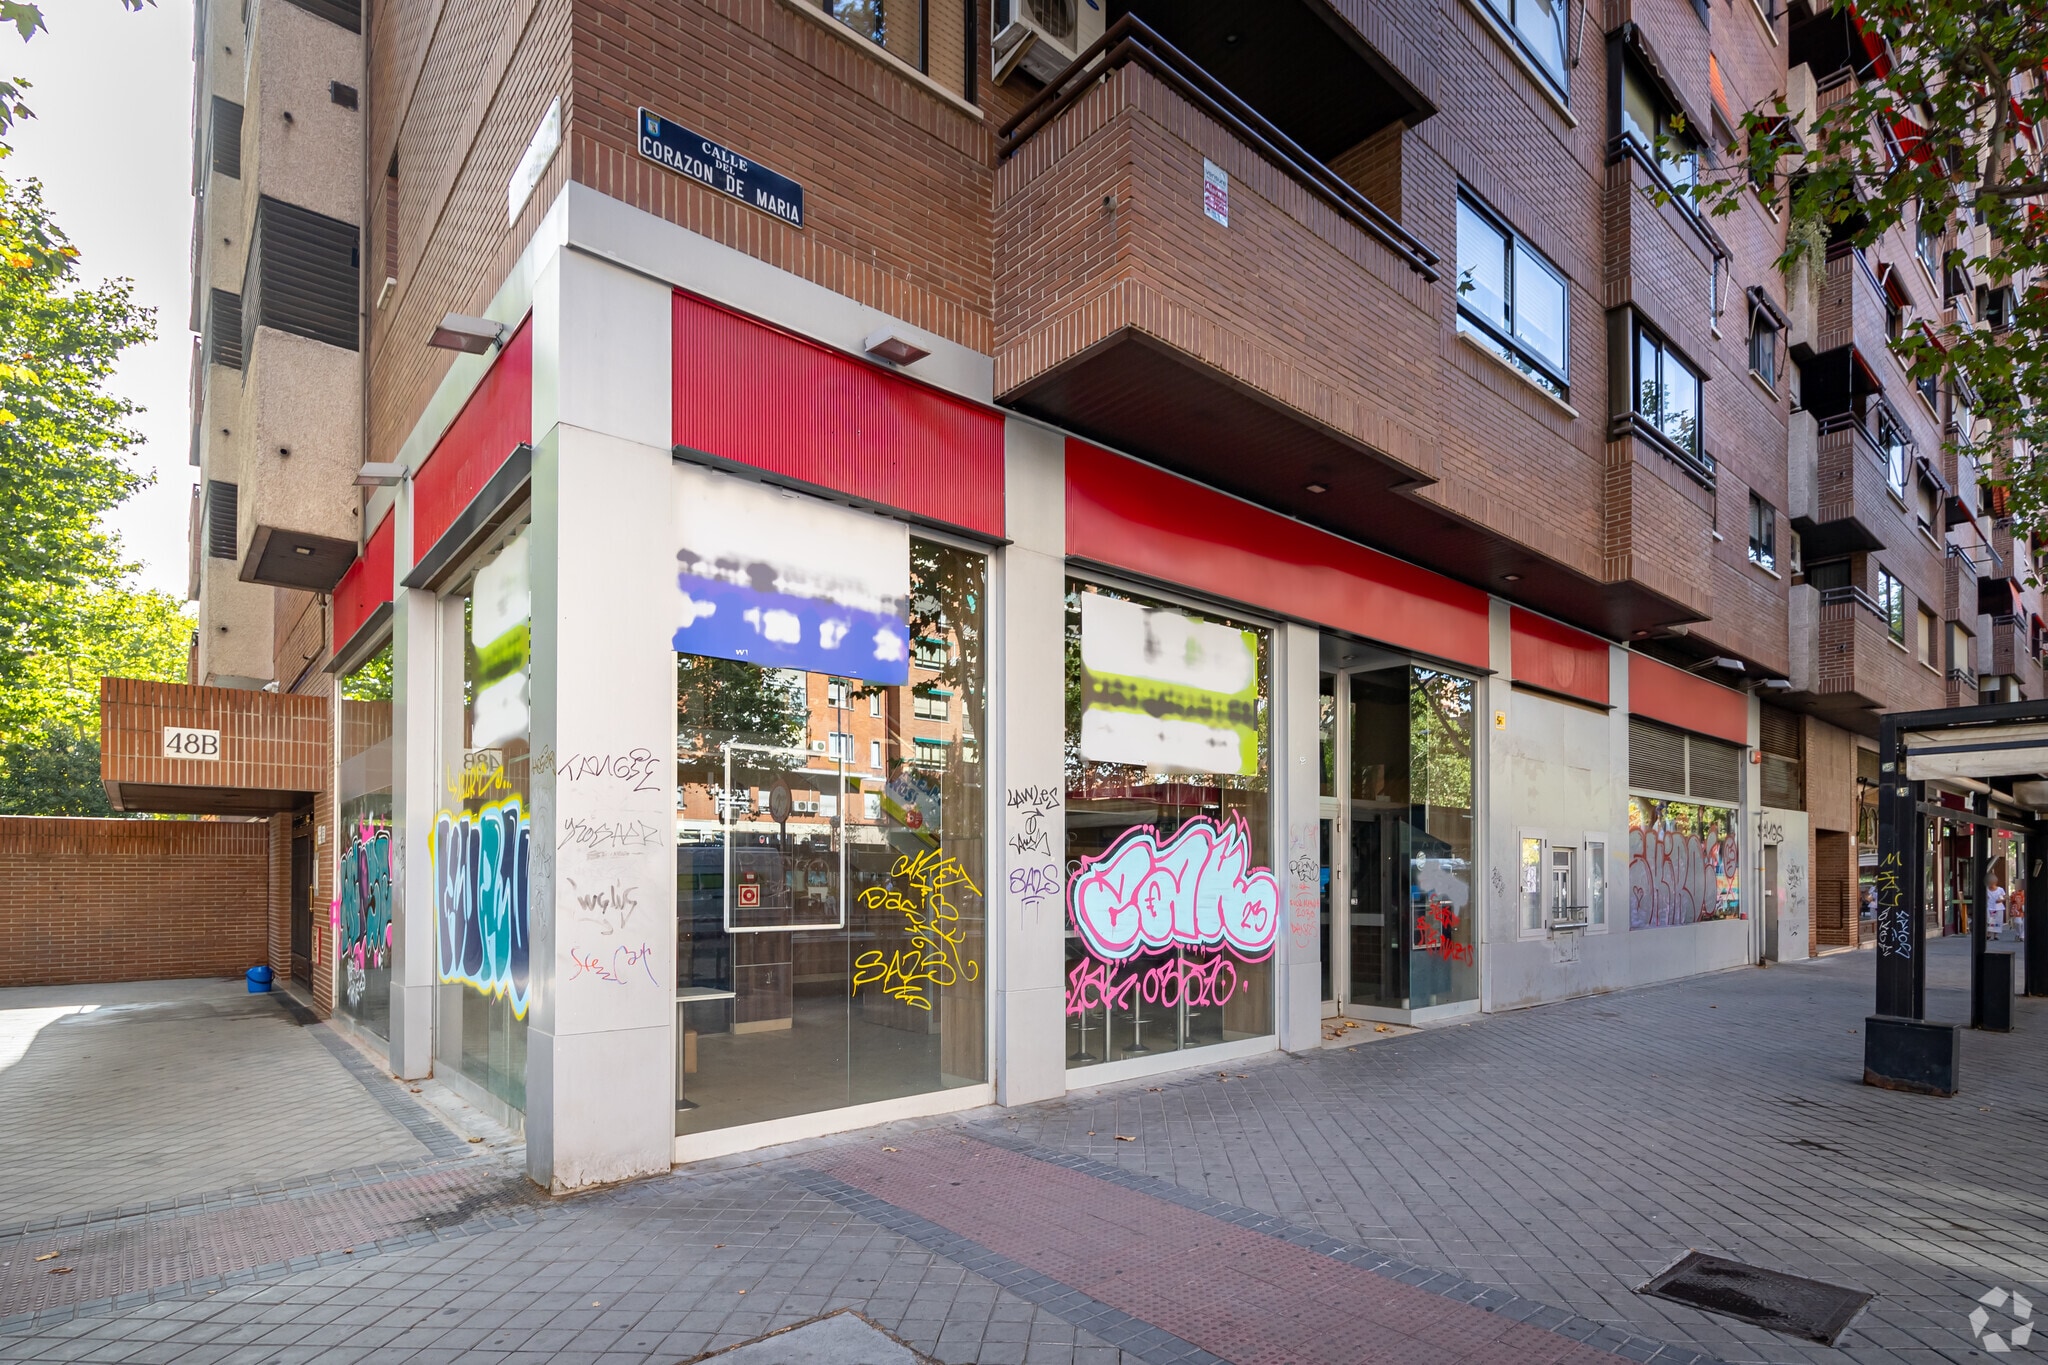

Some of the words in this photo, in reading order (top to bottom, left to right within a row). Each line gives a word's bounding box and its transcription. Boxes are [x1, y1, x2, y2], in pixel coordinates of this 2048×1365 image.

[702, 141, 748, 173] CALLE
[715, 160, 736, 176] DEL
[642, 136, 713, 184] CORAZON
[726, 173, 745, 198] DE
[756, 188, 800, 223] MARIA
[166, 732, 218, 755] 48B
